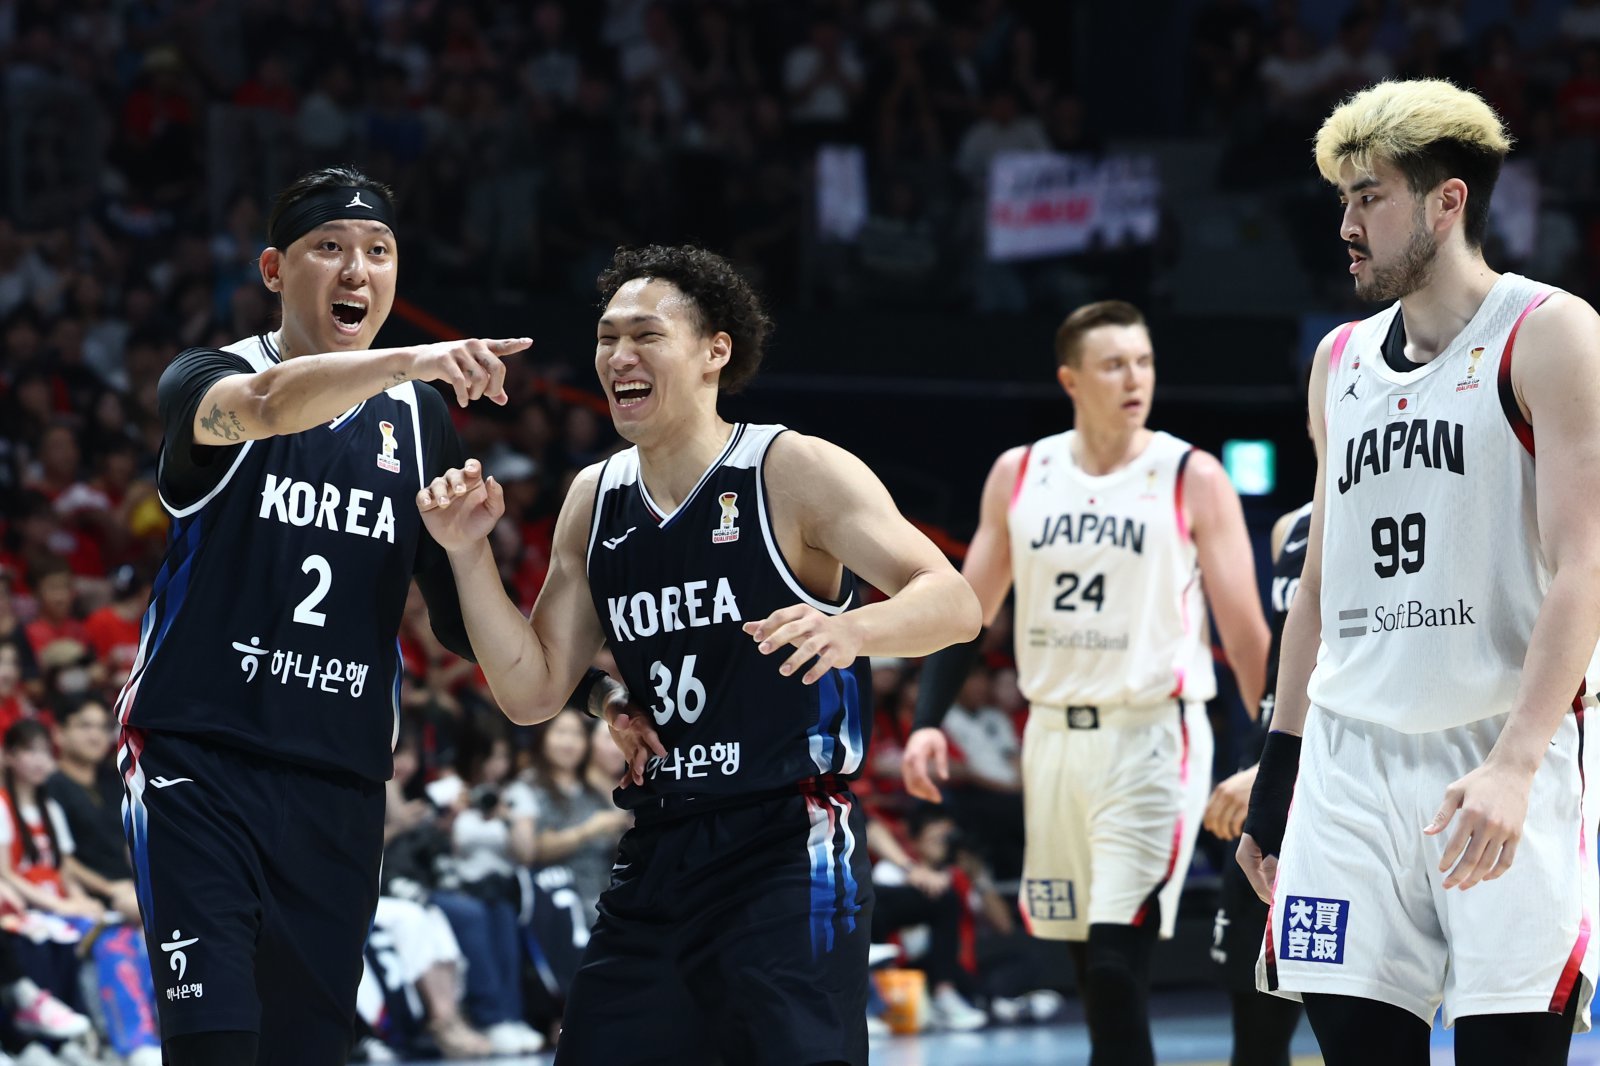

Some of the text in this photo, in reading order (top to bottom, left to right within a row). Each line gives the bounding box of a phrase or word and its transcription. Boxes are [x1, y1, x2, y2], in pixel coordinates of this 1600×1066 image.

[1338, 419, 1465, 495] JAPAN
[259, 473, 396, 544] KOREA
[1030, 513, 1146, 555] JAPAN
[1371, 512, 1426, 579] 99
[293, 554, 333, 627] 2
[607, 577, 742, 642] KOREA
[1054, 571, 1105, 612] 24
[1372, 599, 1476, 633] SoftBank
[270, 649, 370, 698] 하나은행
[650, 654, 707, 726] 36
[166, 982, 203, 1002] 하나은행
